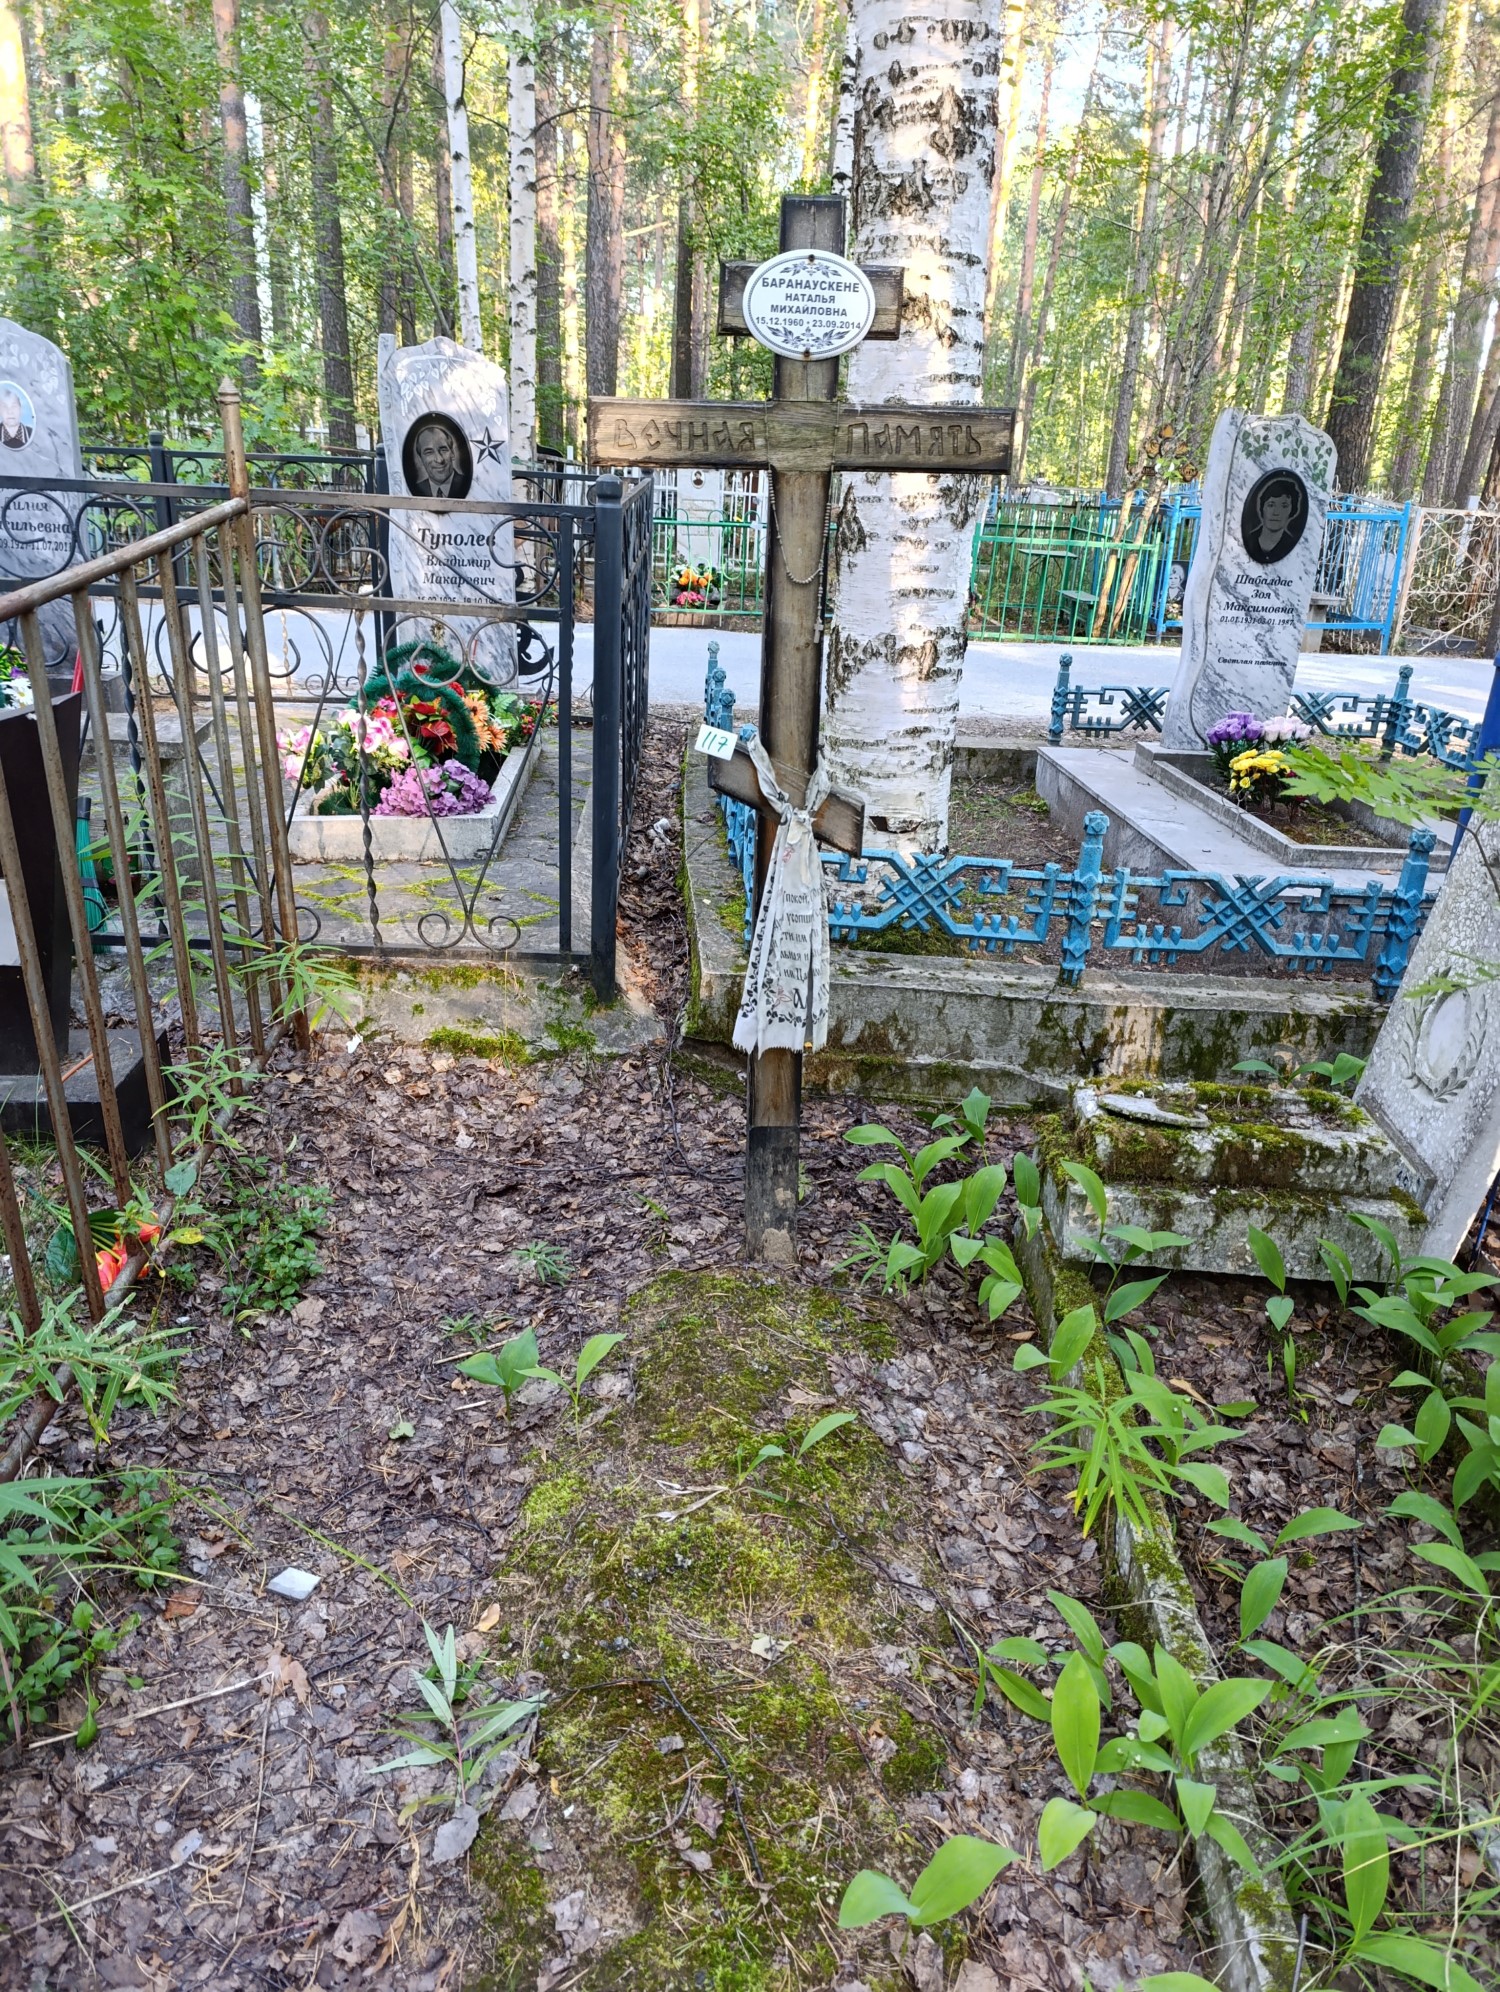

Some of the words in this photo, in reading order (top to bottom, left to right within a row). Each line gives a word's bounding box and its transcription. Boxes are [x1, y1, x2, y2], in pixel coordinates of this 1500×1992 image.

[761, 277, 860, 293] БАРАНАУСКЕНЕ
[785, 293, 836, 304] НАТАЛЬЯ
[770, 304, 848, 317] МИХАЙЛОВНА
[755, 316, 804, 327] 15.12.1960
[812, 319, 861, 329] 23.09.2014
[417, 528, 496, 549] Туполев
[1235, 574, 1293, 588] Шабалдас
[1250, 588, 1272, 600] Зоя
[1223, 601, 1295, 614] Максимовна
[701, 730, 729, 753] 117
